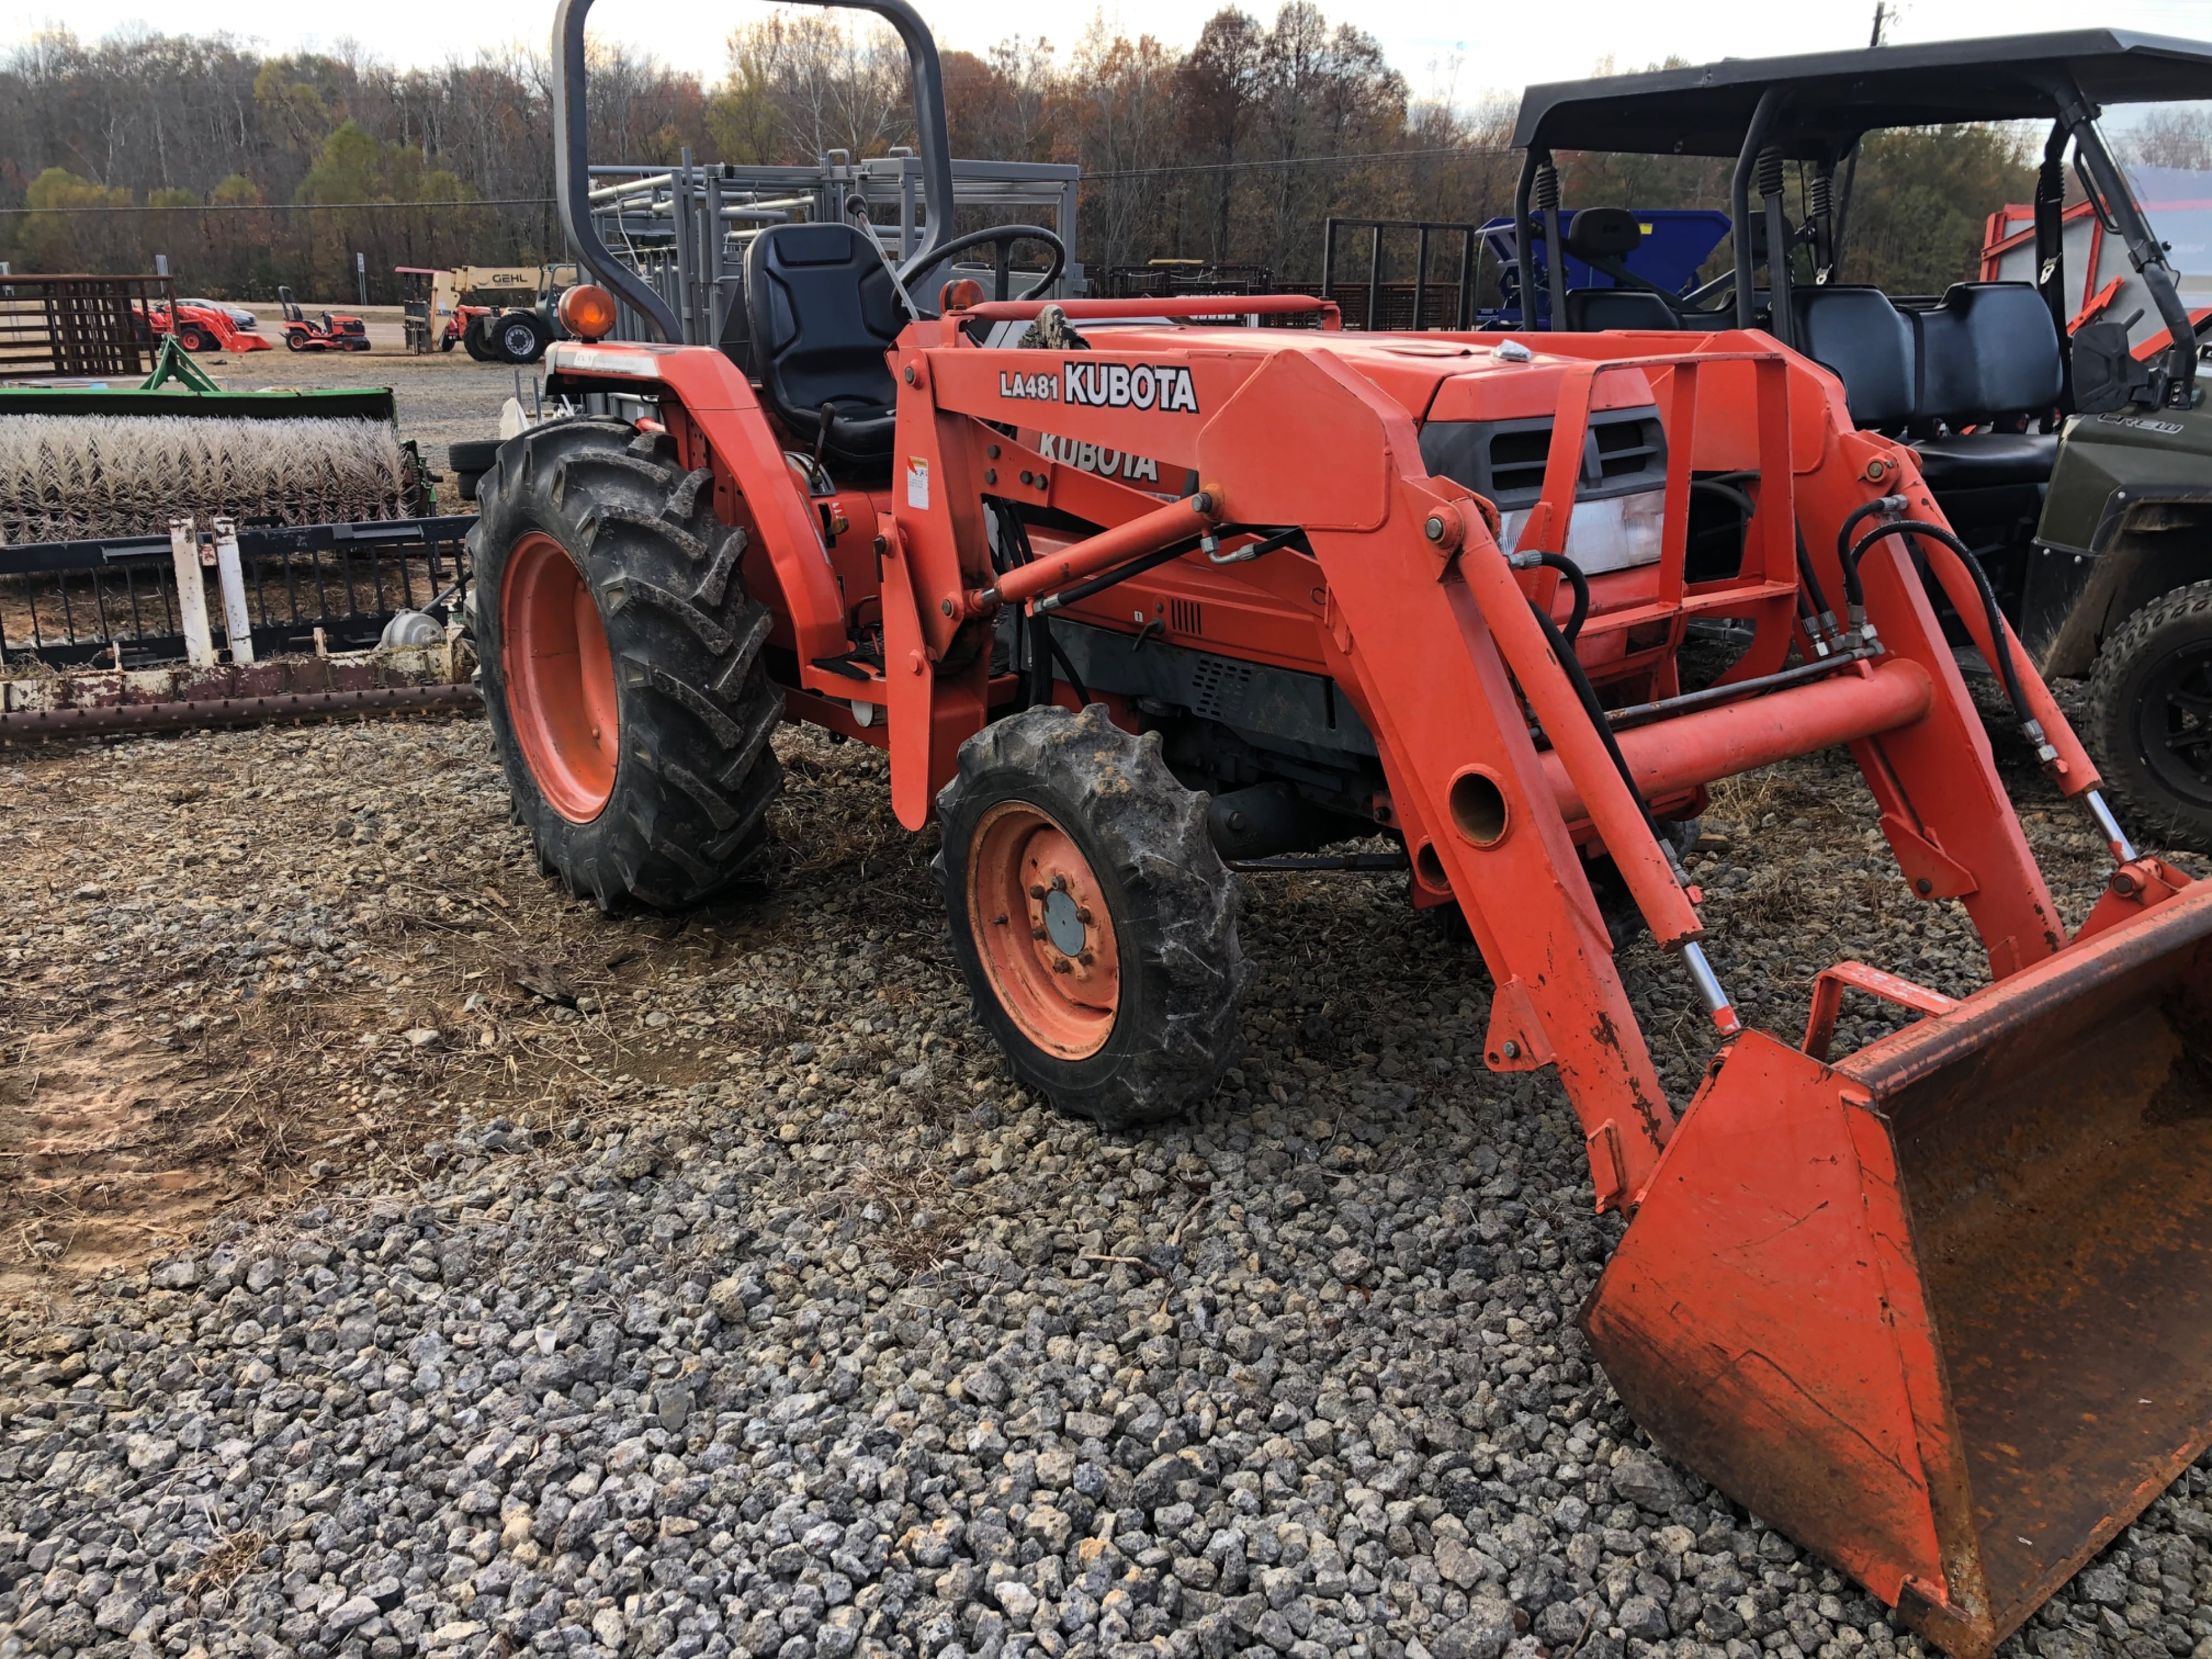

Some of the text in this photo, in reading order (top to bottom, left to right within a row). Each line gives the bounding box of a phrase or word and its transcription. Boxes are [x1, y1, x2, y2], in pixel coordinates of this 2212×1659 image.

[492, 274, 528, 283] GEHL
[1000, 361, 1199, 414] LA481 KUBOTA
[2097, 413, 2184, 434] CREW
[1040, 432, 1159, 483] KUBOTA
